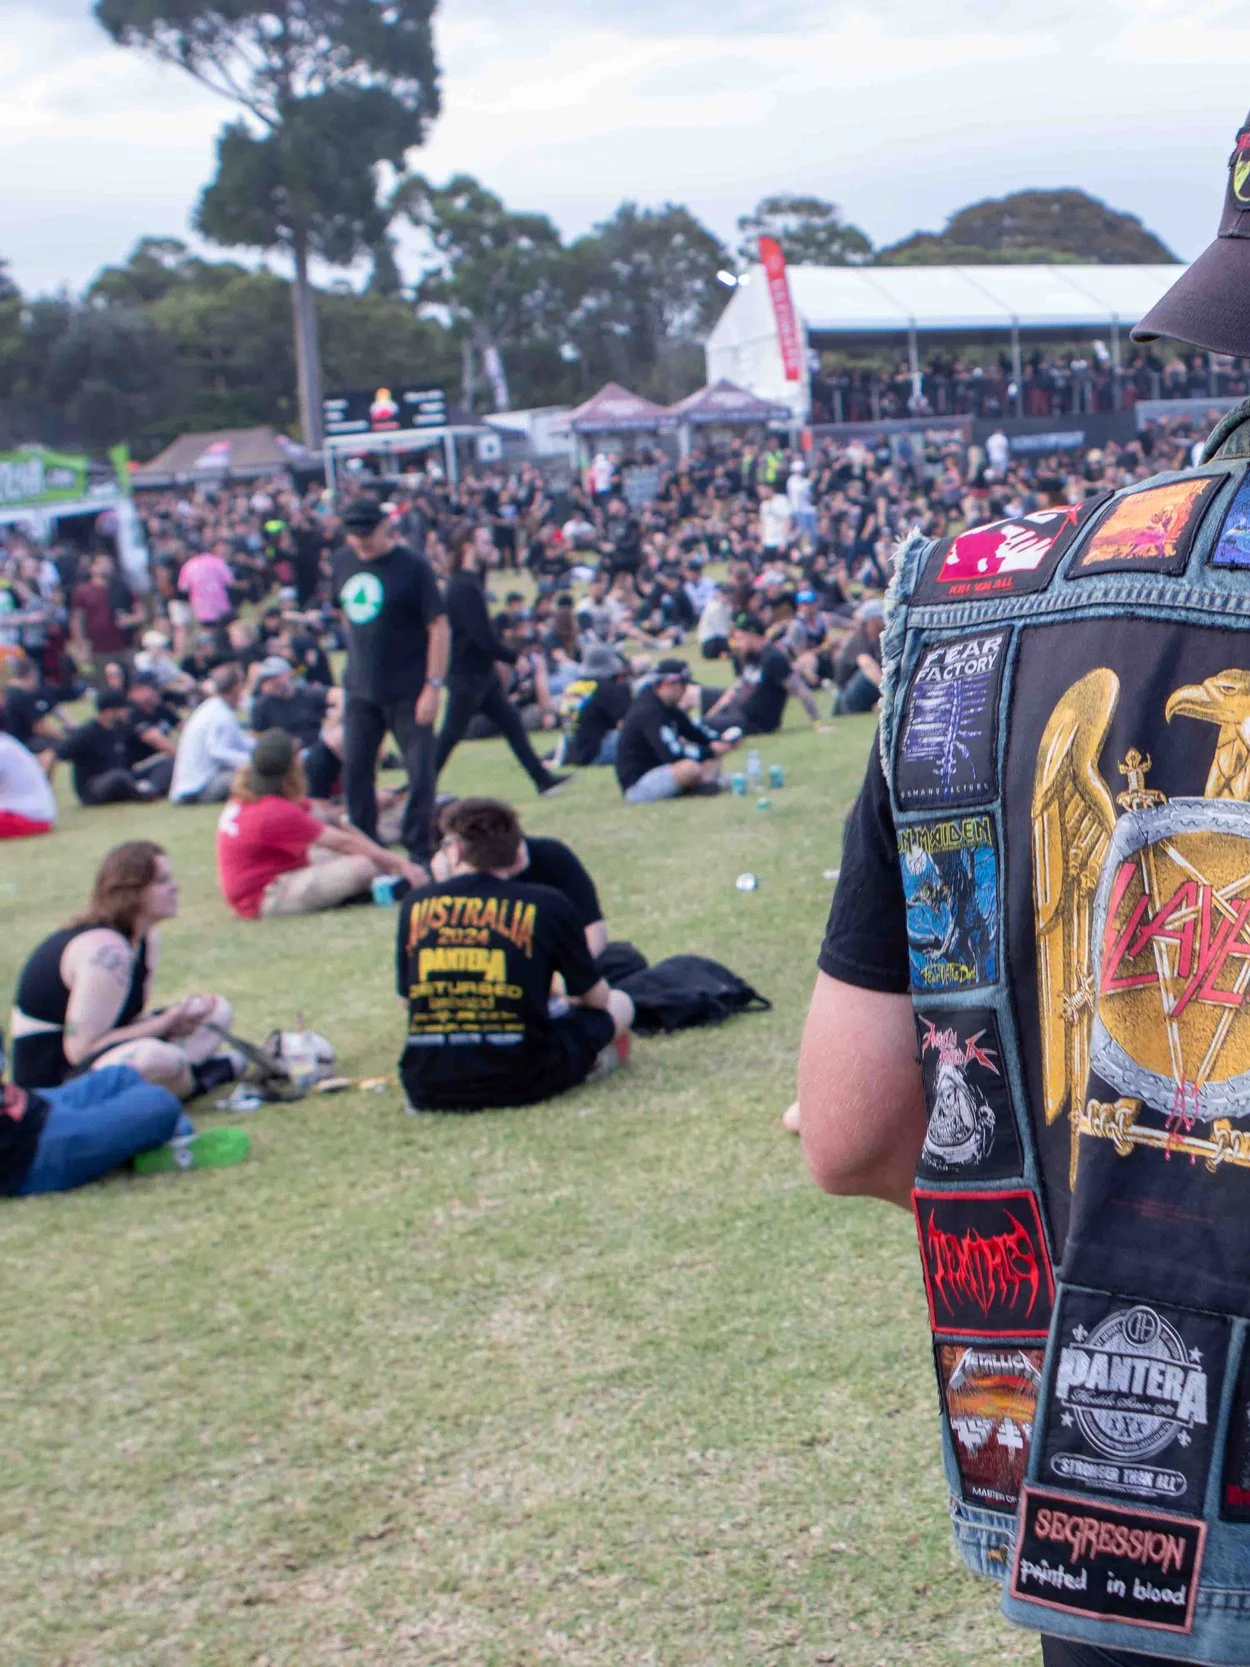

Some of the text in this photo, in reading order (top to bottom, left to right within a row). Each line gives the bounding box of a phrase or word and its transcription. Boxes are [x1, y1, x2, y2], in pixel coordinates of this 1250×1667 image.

[923, 633, 1004, 668] FEAR
[915, 654, 998, 684] FACTORY
[917, 816, 993, 853] MAIDEN
[405, 895, 537, 959] AUSTRALIA
[419, 947, 506, 982] PANTERA
[1056, 1347, 1208, 1425] PANTERA
[1035, 1508, 1186, 1575] SEGRESSION
[1106, 1571, 1126, 1598] in
[1132, 1578, 1187, 1606] blood
